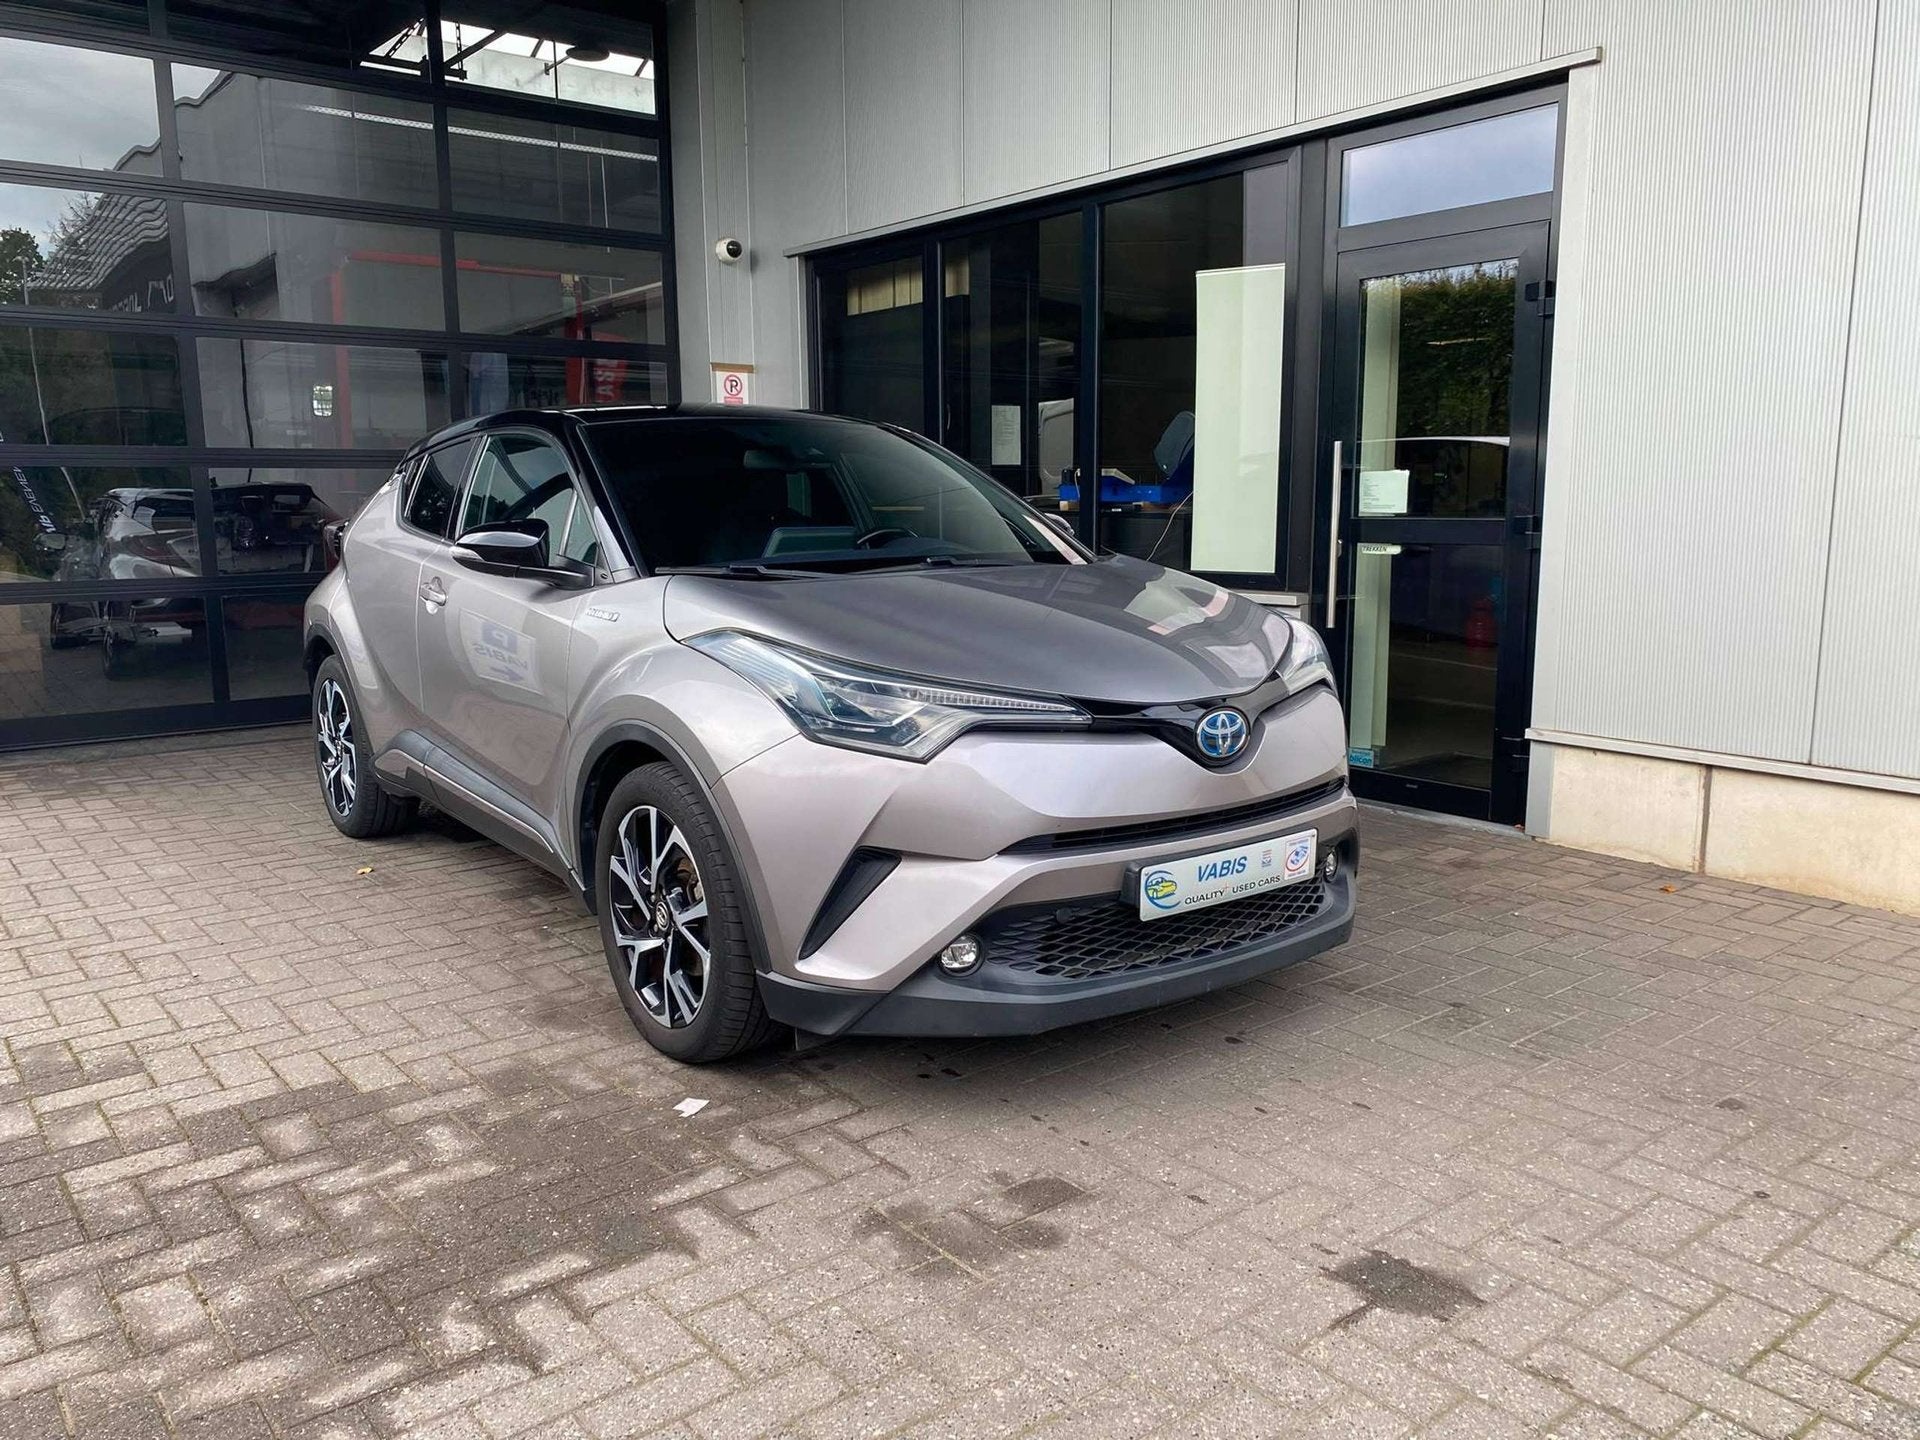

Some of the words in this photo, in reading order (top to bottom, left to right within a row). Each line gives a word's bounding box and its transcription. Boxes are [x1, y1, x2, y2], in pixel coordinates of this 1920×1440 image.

[1198, 856, 1247, 882] VABIS
[1184, 889, 1225, 905] QUALITY
[1232, 882, 1257, 894] USED
[1257, 875, 1281, 887] CARS
